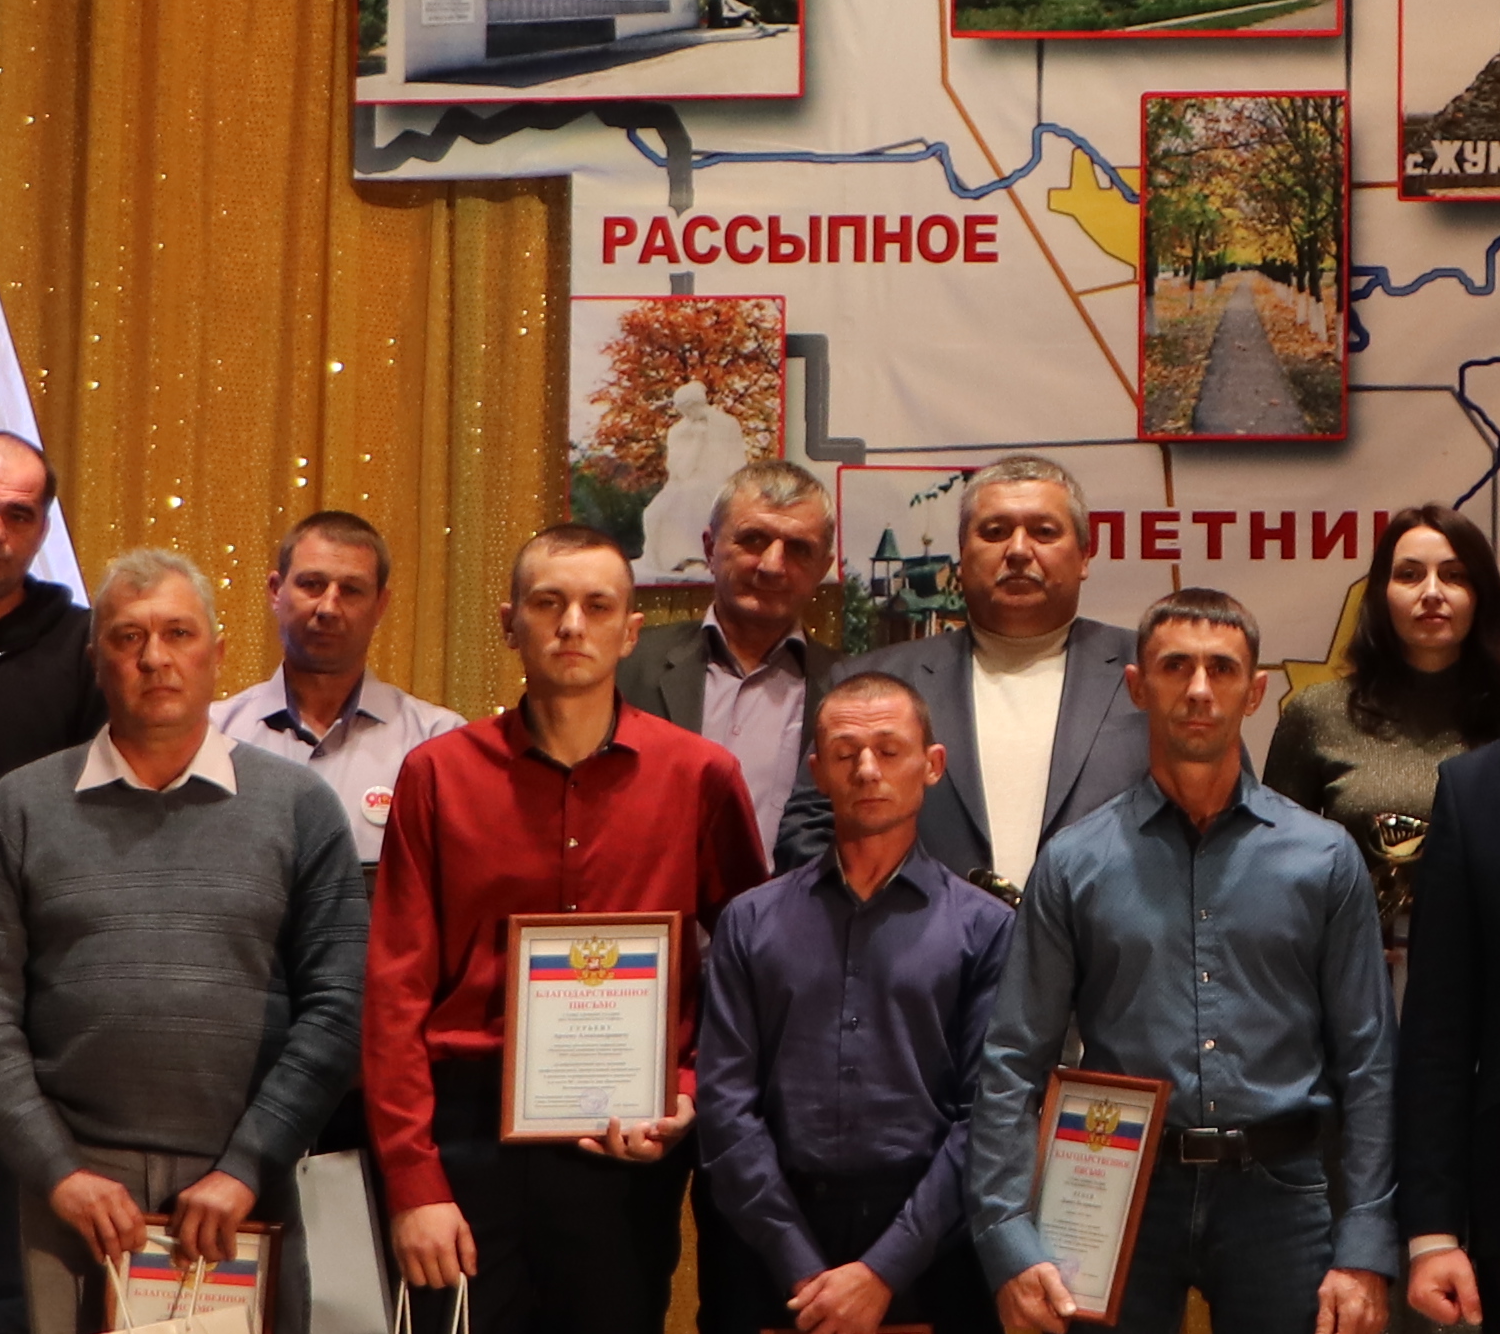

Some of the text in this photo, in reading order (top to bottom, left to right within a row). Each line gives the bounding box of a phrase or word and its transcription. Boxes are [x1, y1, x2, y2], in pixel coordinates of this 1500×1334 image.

[601, 213, 1000, 266] РАССЫПНОЕ
[1088, 510, 1389, 561] ЛЕТНИ
[535, 988, 649, 998] БЛАГОДАРСТВЕННОЕ
[569, 1000, 617, 1009] ПИСЬМО
[134, 1288, 247, 1303] БЛАГОДАРТВЕННОЕ
[167, 1302, 215, 1313] ПИСМО
